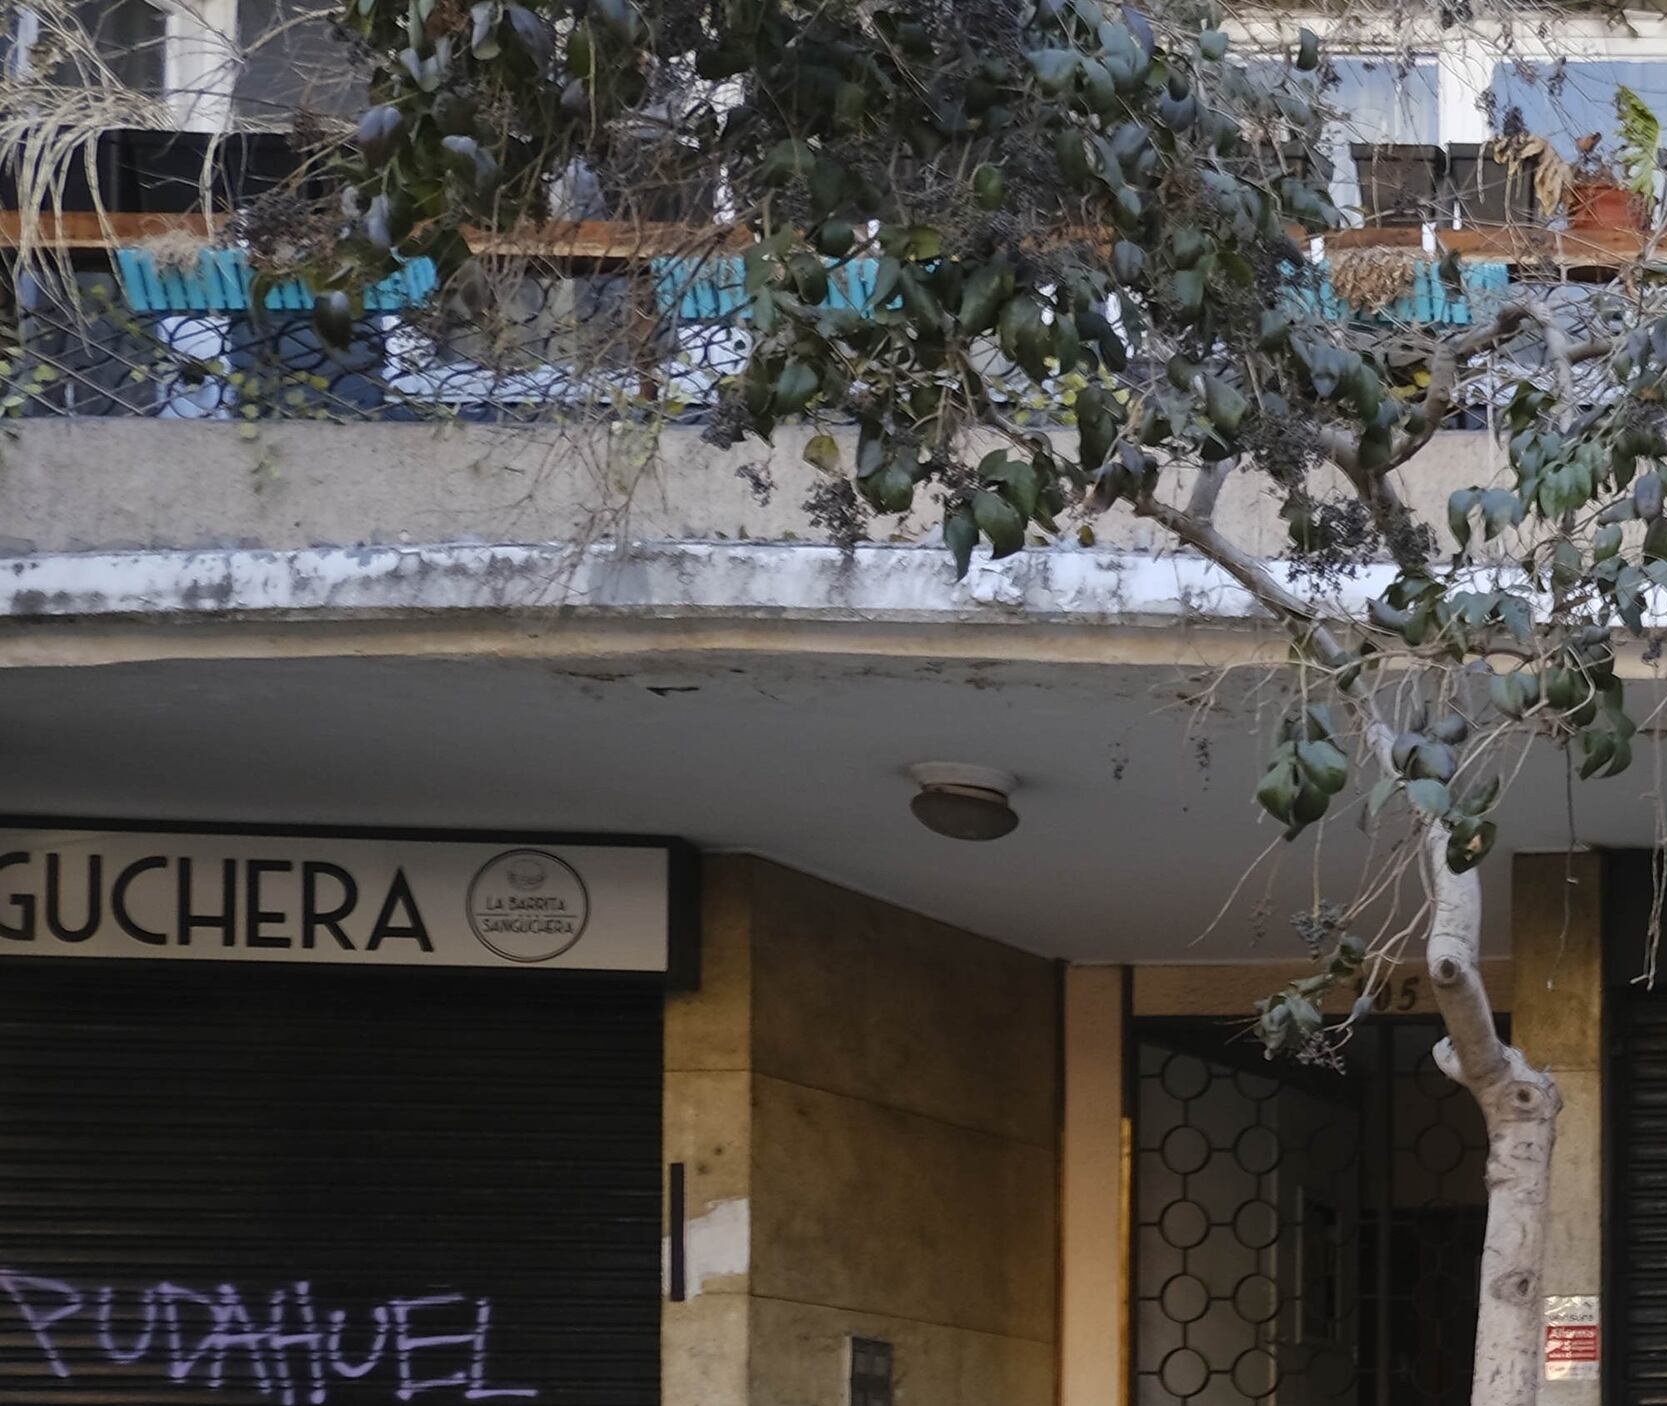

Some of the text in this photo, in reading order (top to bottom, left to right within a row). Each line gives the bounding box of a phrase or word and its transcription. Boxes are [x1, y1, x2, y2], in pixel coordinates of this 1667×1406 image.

[0, 851, 434, 953] GUCHERA
[485, 896, 566, 912] LA BARRITA
[482, 918, 575, 935] SANGUCHERA
